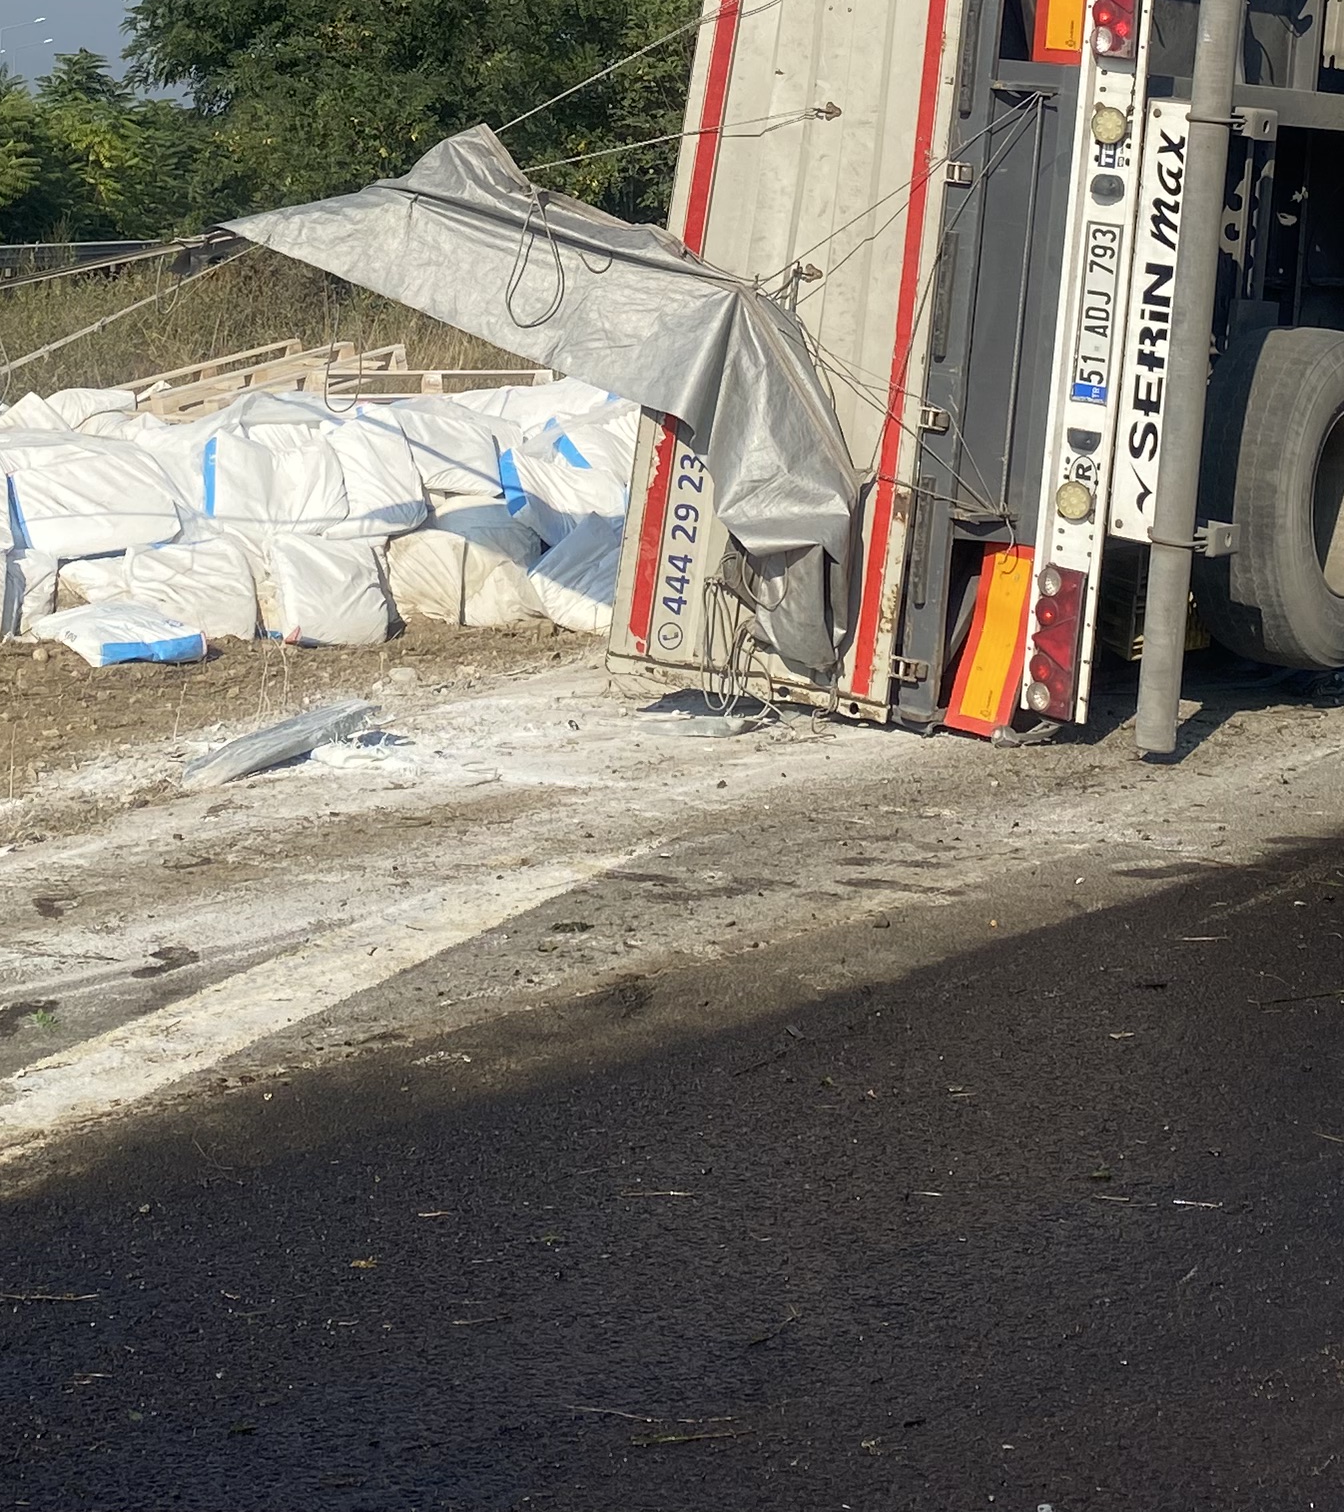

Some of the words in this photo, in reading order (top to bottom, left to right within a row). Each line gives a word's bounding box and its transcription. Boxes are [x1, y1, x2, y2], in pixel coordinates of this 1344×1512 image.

[1150, 129, 1186, 252] max
[1088, 228, 1117, 275] 793
[1084, 289, 1112, 338] ADJ
[1079, 354, 1106, 385] 51
[1091, 387, 1100, 398] TR
[678, 454, 705, 493] 23
[672, 504, 699, 543] 29
[662, 554, 692, 615] 444
